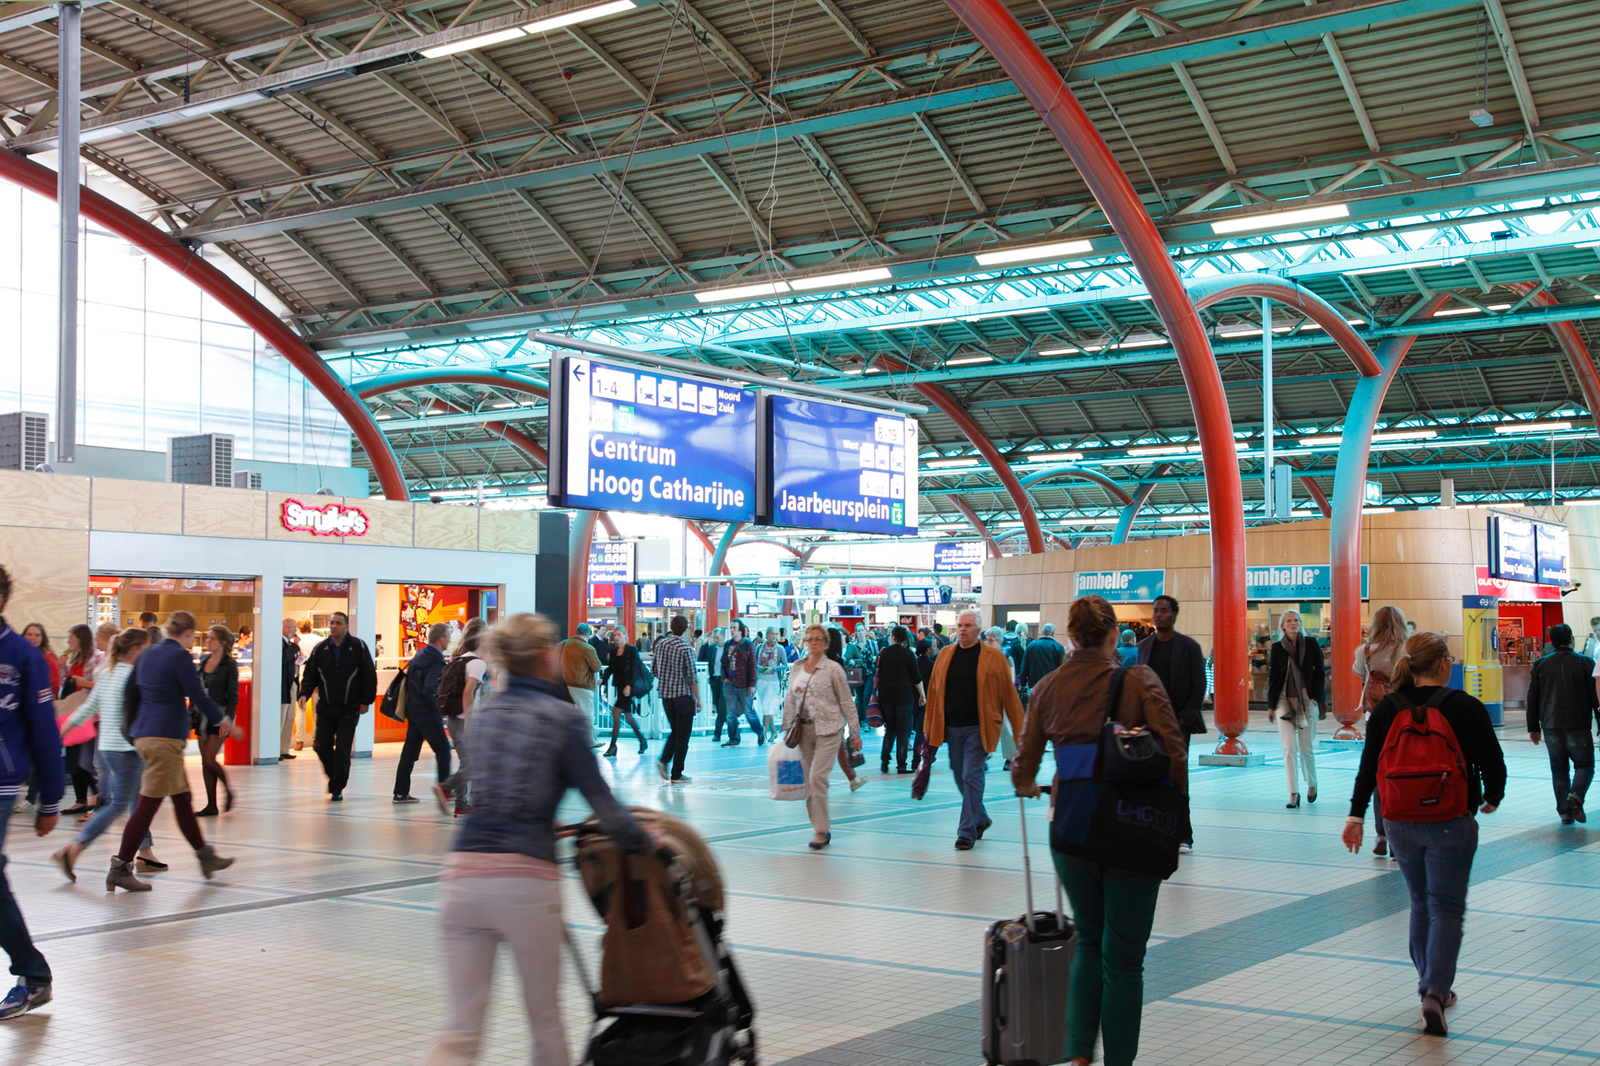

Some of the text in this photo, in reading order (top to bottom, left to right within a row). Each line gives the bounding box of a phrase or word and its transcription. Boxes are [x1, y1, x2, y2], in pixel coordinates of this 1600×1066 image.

[718, 388, 741, 402] Noord
[718, 402, 735, 414] Zuid
[594, 416, 610, 429] WC
[590, 433, 676, 467] Centrum
[842, 439, 859, 451] West
[590, 468, 745, 511] Hoog Catharijne
[780, 489, 890, 523] Jaarbeursplein
[287, 504, 367, 533] Smullers
[1074, 571, 1129, 597] jambelle
[1478, 578, 1492, 586] OLA
[642, 590, 652, 601] 12
